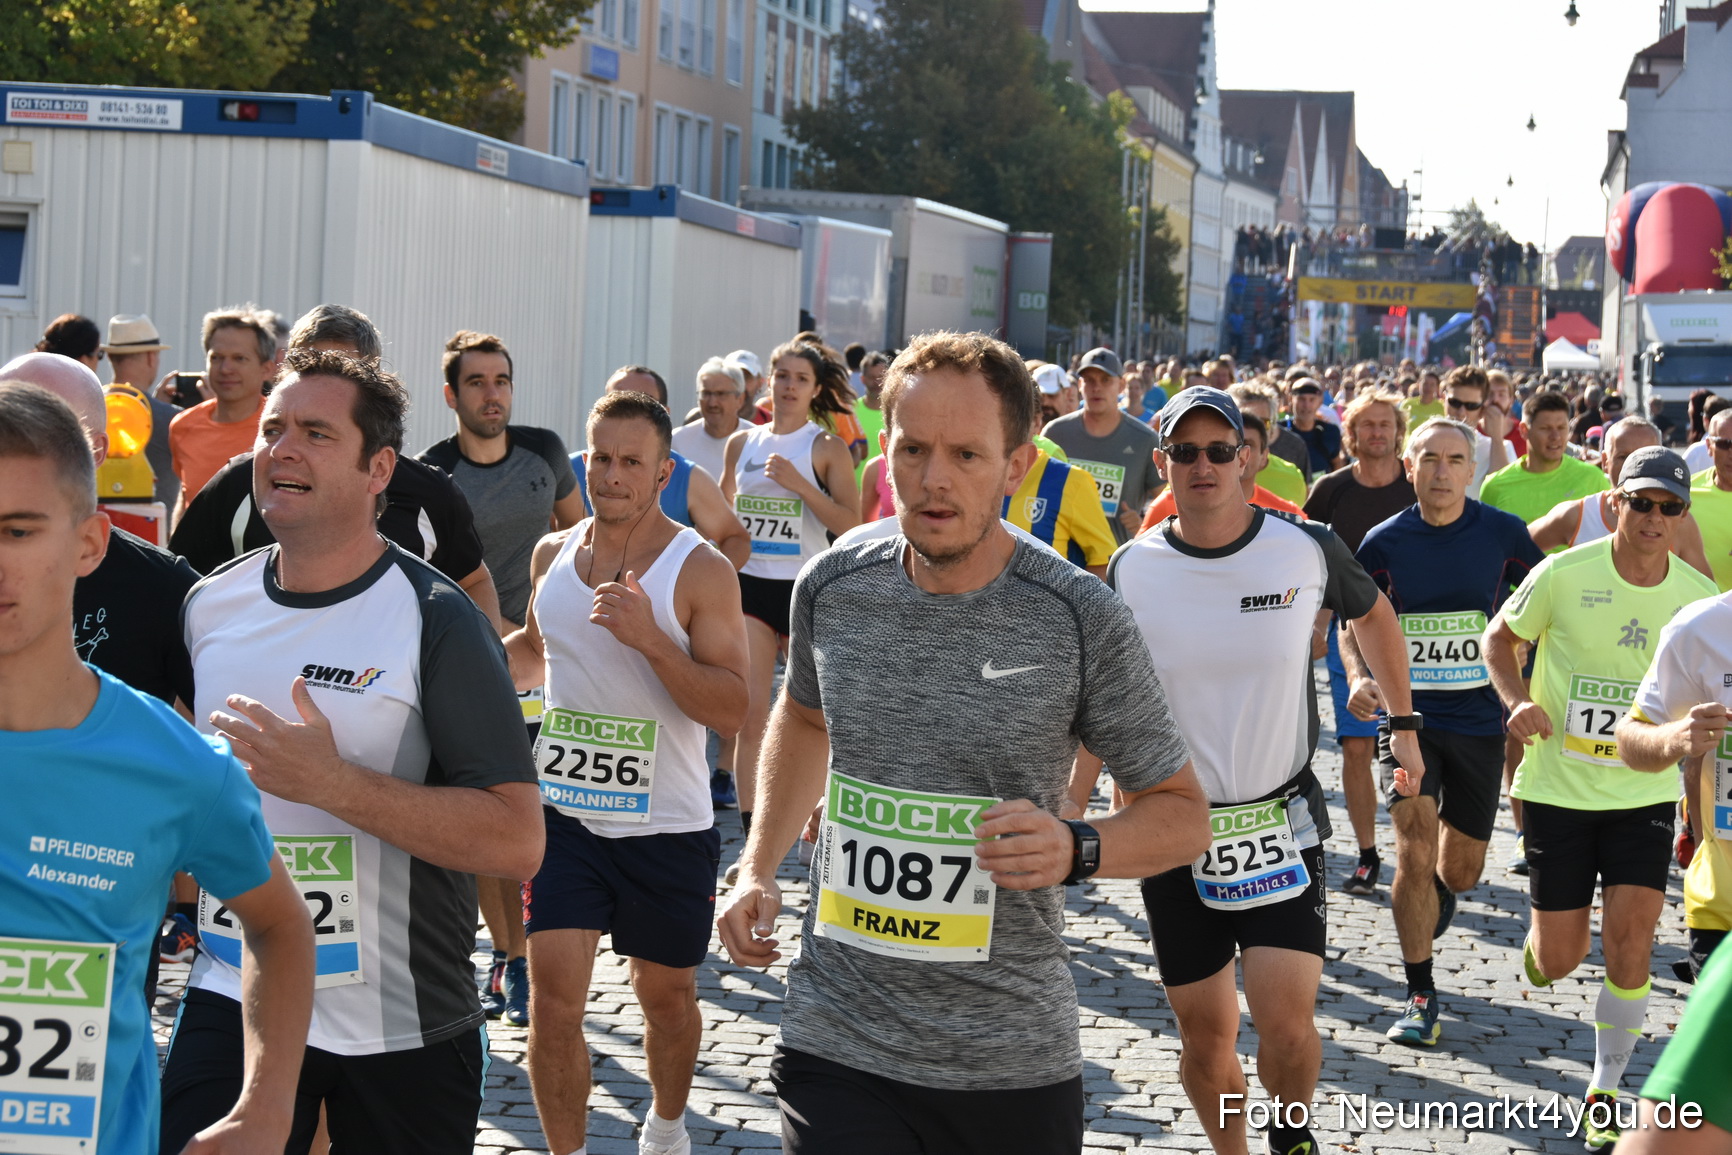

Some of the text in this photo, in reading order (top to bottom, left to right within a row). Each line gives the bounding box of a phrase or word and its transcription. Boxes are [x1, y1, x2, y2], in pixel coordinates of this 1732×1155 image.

[12, 97, 87, 112] TOI TOI & DIXI
[1355, 284, 1417, 301] START
[1078, 462, 1118, 480] OCK
[741, 497, 794, 515] BOCK
[742, 516, 793, 539] 2774
[1240, 593, 1281, 608] swn
[1406, 615, 1480, 634] BOCK
[1411, 639, 1480, 663] 2440
[300, 663, 355, 685] swn
[1412, 668, 1481, 680] WOLFGANG
[332, 685, 365, 695] neumarkt
[550, 711, 645, 747] BOCK
[1594, 744, 1617, 756] PE
[544, 744, 640, 787] 2256
[541, 785, 638, 809] JOHANNES
[838, 784, 980, 839] BOCK
[47, 838, 135, 868] PFLEIDERER
[1201, 834, 1285, 877] 2525
[27, 863, 117, 892] Alexander
[841, 838, 973, 904] 1087
[1216, 874, 1290, 900] Matthias
[853, 907, 941, 941] FRANZ
[0, 950, 84, 997] CK
[83, 1024, 95, 1037] C
[1, 1099, 71, 1127] DER
